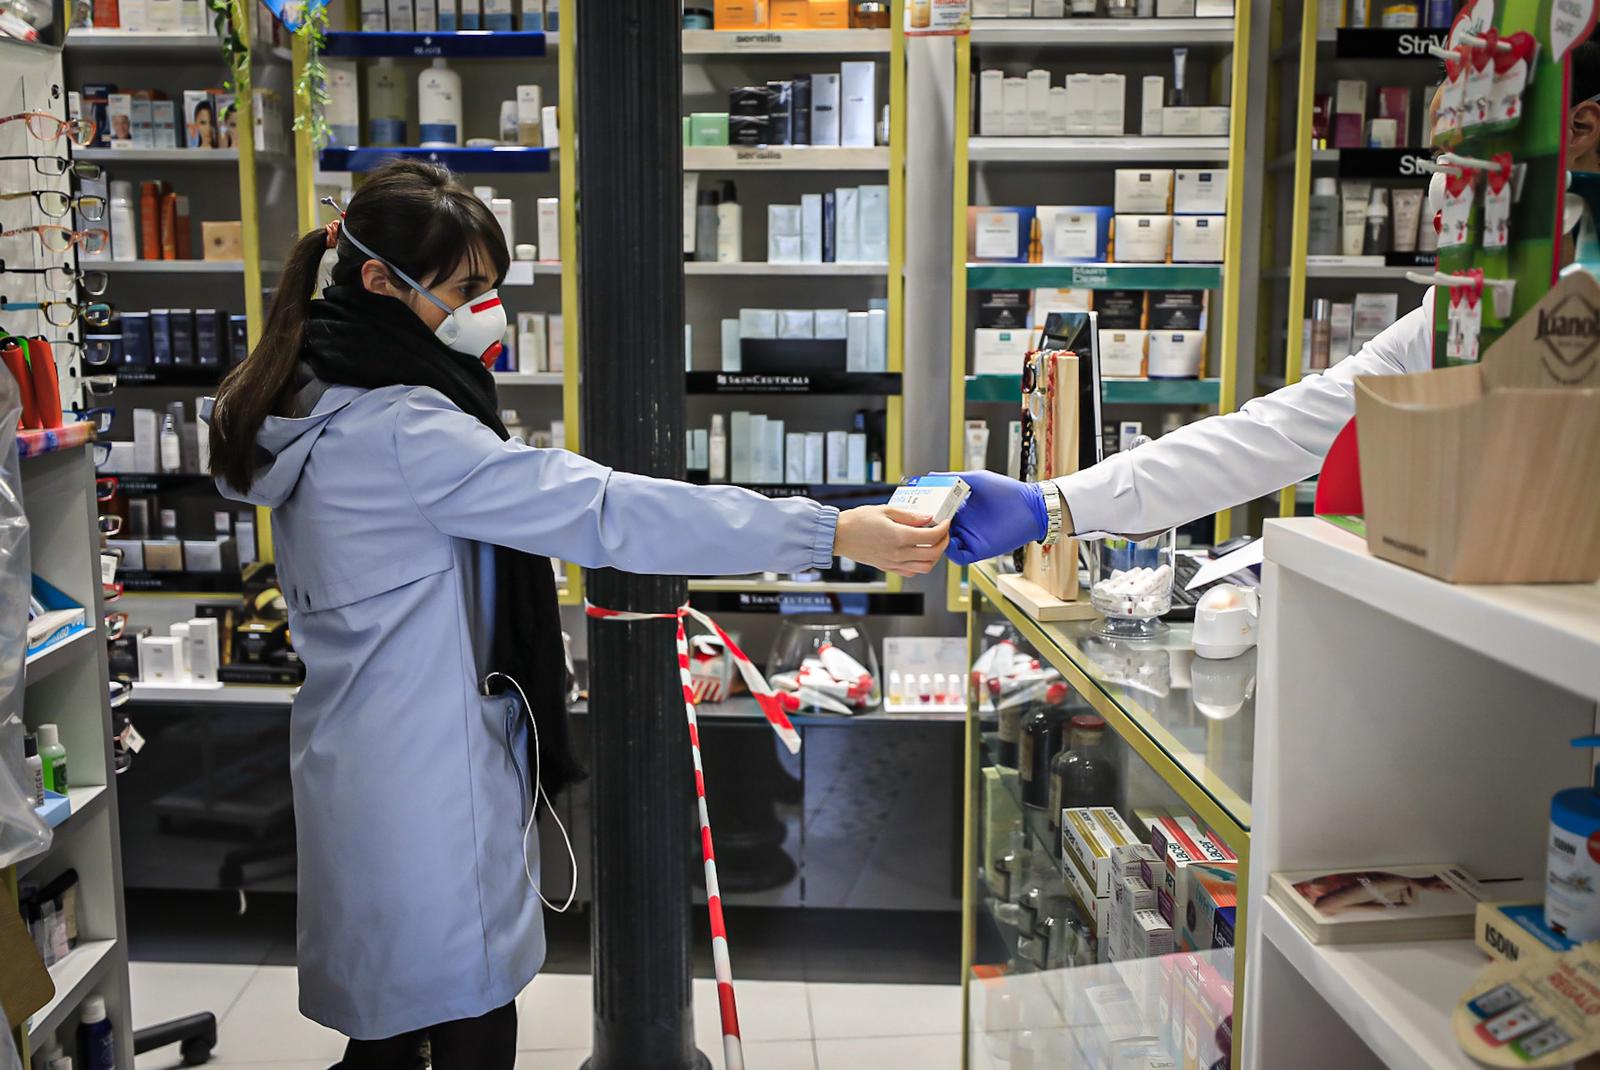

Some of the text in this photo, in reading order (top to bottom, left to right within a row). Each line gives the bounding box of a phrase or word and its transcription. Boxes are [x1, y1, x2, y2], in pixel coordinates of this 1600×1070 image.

[736, 33, 782, 43] sensilis
[1398, 34, 1448, 55] StriV
[1485, 922, 1520, 962] ISDIN
